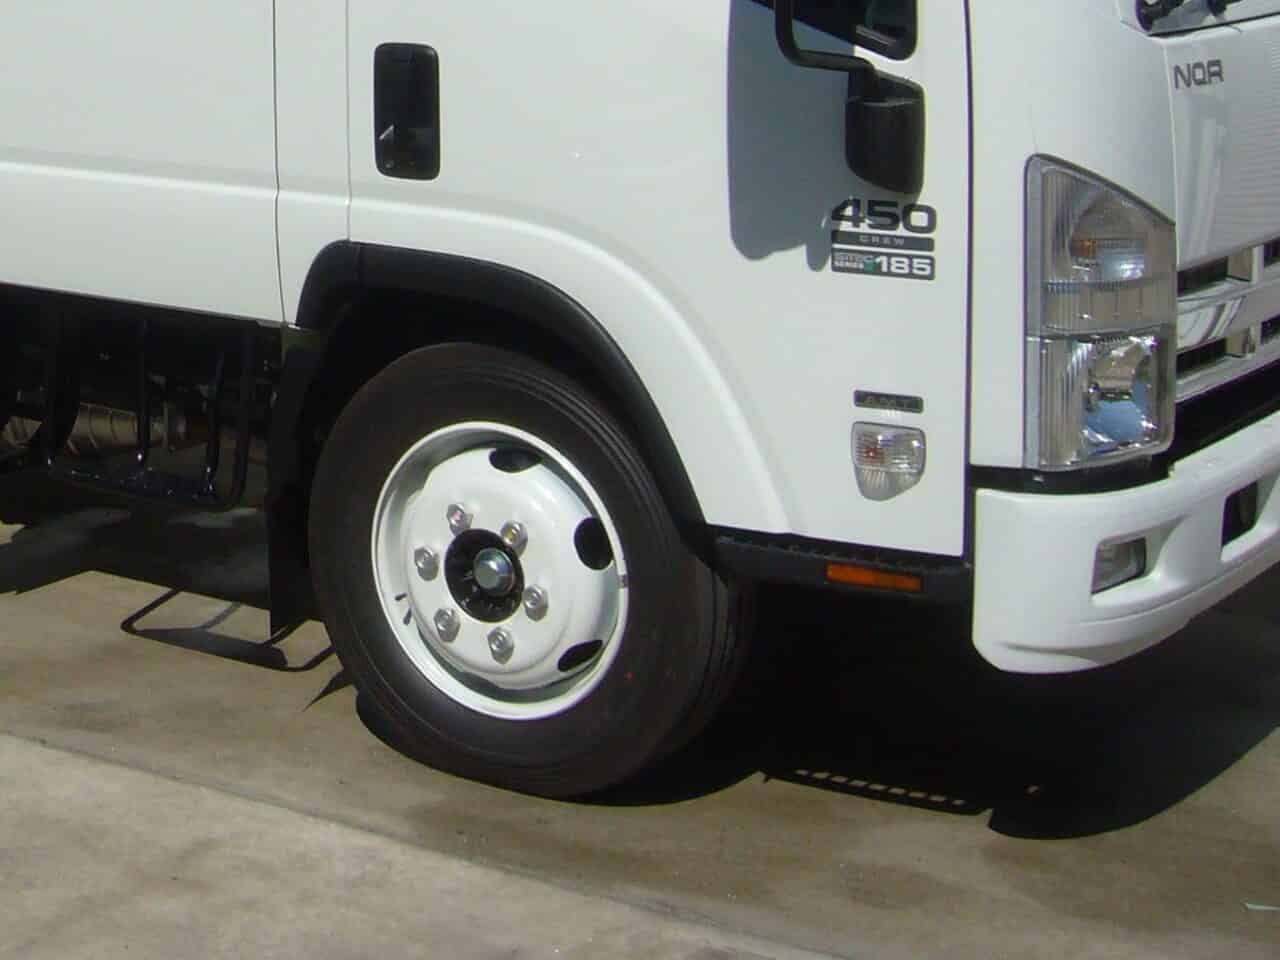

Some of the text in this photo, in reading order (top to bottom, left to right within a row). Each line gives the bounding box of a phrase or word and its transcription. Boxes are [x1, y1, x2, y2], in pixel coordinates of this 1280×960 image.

[1173, 59, 1225, 90] NQR
[831, 198, 937, 234] 450
[875, 256, 932, 276] 185
